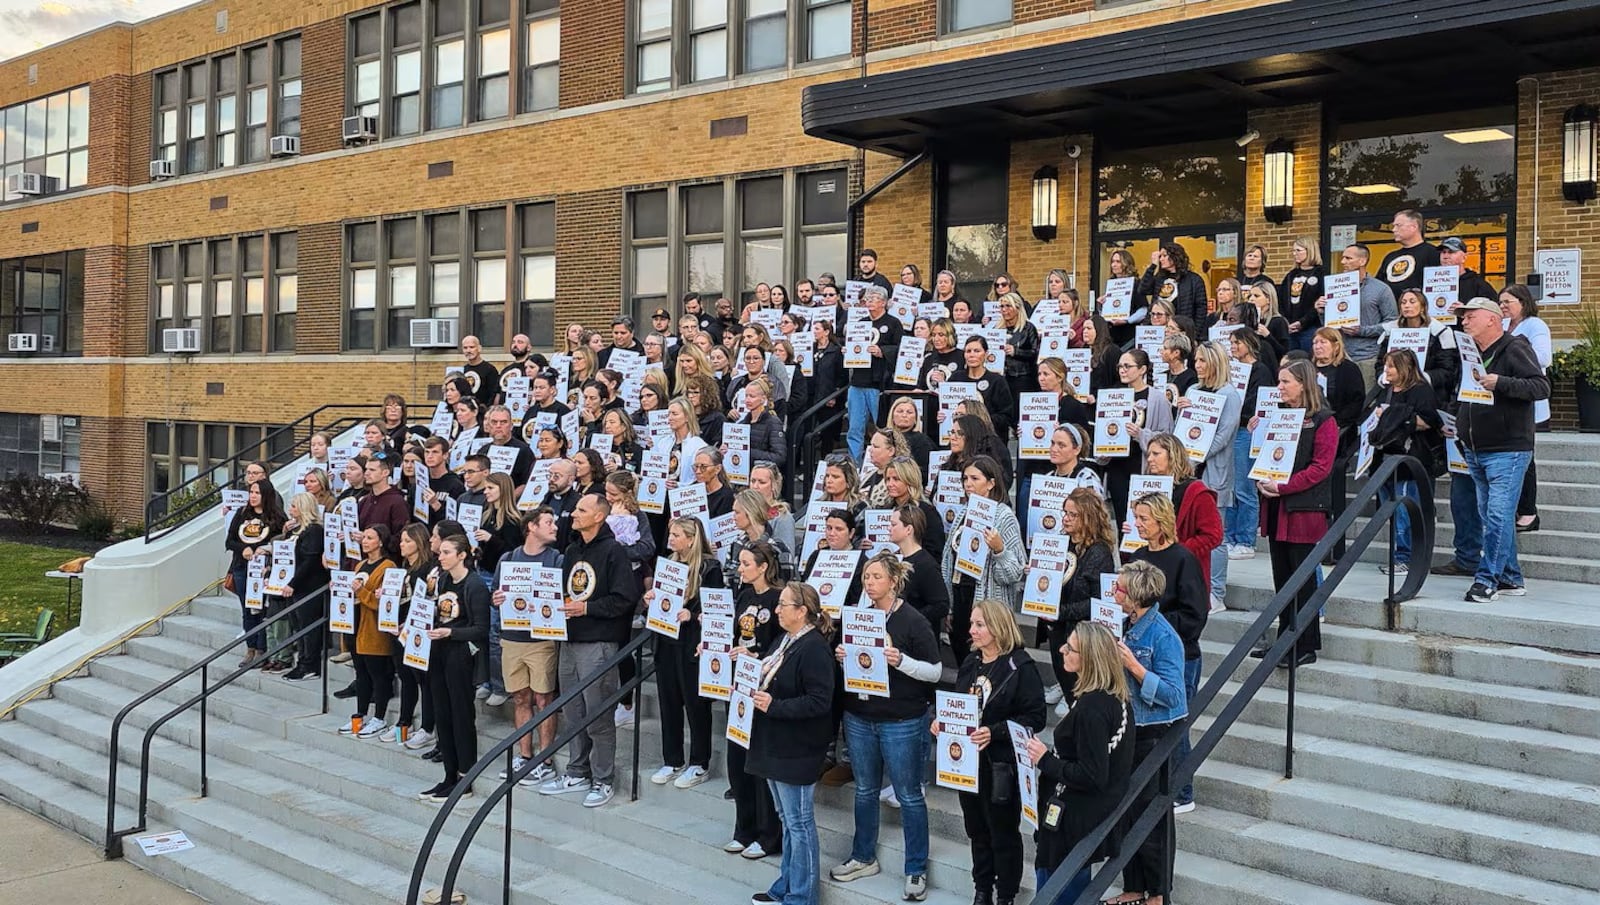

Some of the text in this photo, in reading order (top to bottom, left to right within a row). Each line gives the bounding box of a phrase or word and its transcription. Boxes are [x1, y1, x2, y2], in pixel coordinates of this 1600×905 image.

[1044, 481, 1064, 490] FAIR!
[855, 613, 874, 622] FAIR!
[847, 623, 882, 633] CONTRACT!
[947, 699, 965, 709] FAIR!
[940, 710, 974, 721] CONTRACT!
